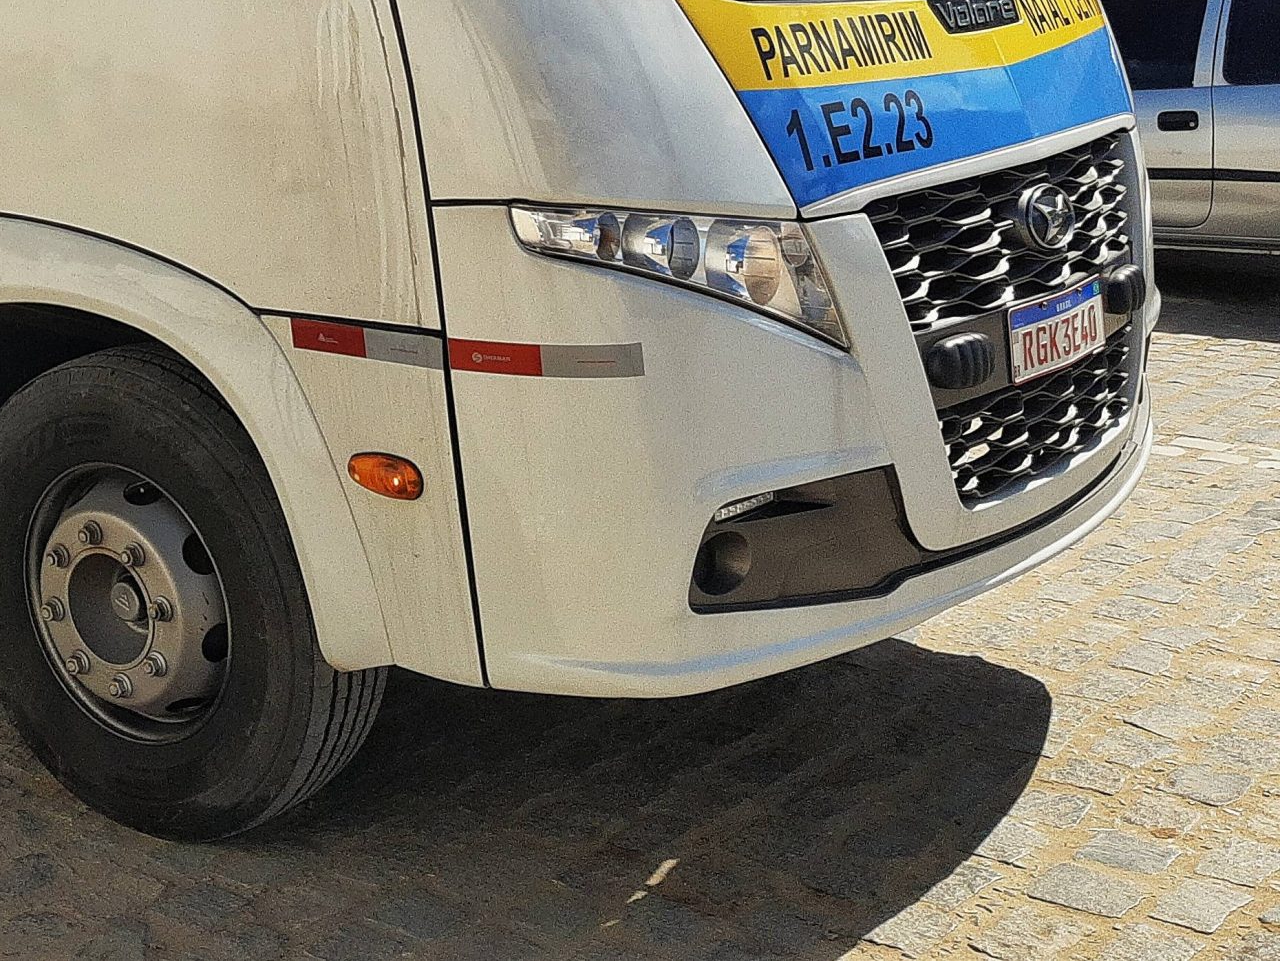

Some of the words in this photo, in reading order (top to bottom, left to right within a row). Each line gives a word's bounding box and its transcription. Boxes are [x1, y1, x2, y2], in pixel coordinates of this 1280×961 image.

[750, 10, 933, 81] PARNAMIRIM
[786, 89, 934, 172] 1.E2.23
[1021, 304, 1098, 371] RGK3E40
